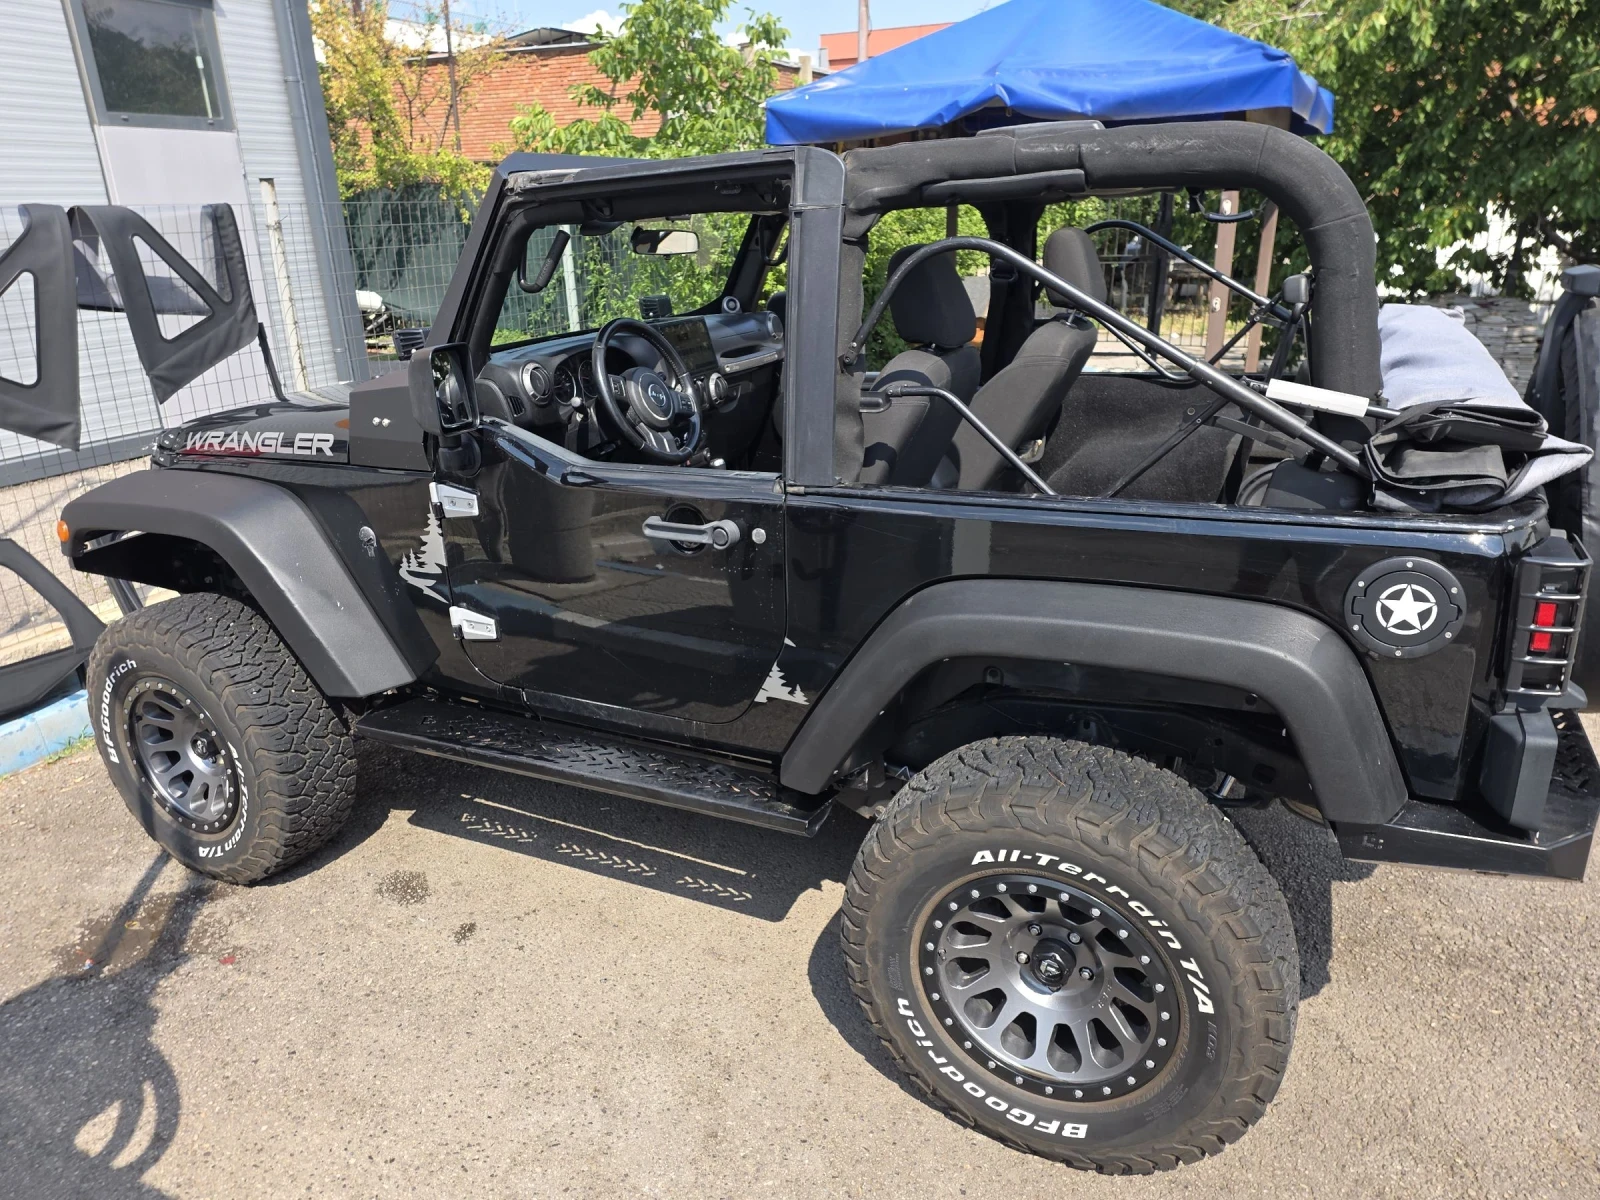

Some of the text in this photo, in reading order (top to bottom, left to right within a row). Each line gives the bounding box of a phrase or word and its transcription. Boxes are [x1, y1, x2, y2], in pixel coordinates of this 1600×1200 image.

[186, 430, 335, 457] WRANGLER
[101, 659, 138, 764] BFGoodrich
[198, 741, 249, 858] All-Terrain T/A
[970, 848, 1182, 950] All-Terrain
[1179, 957, 1216, 1014] T/A
[896, 997, 1090, 1140] BFGoodrich
